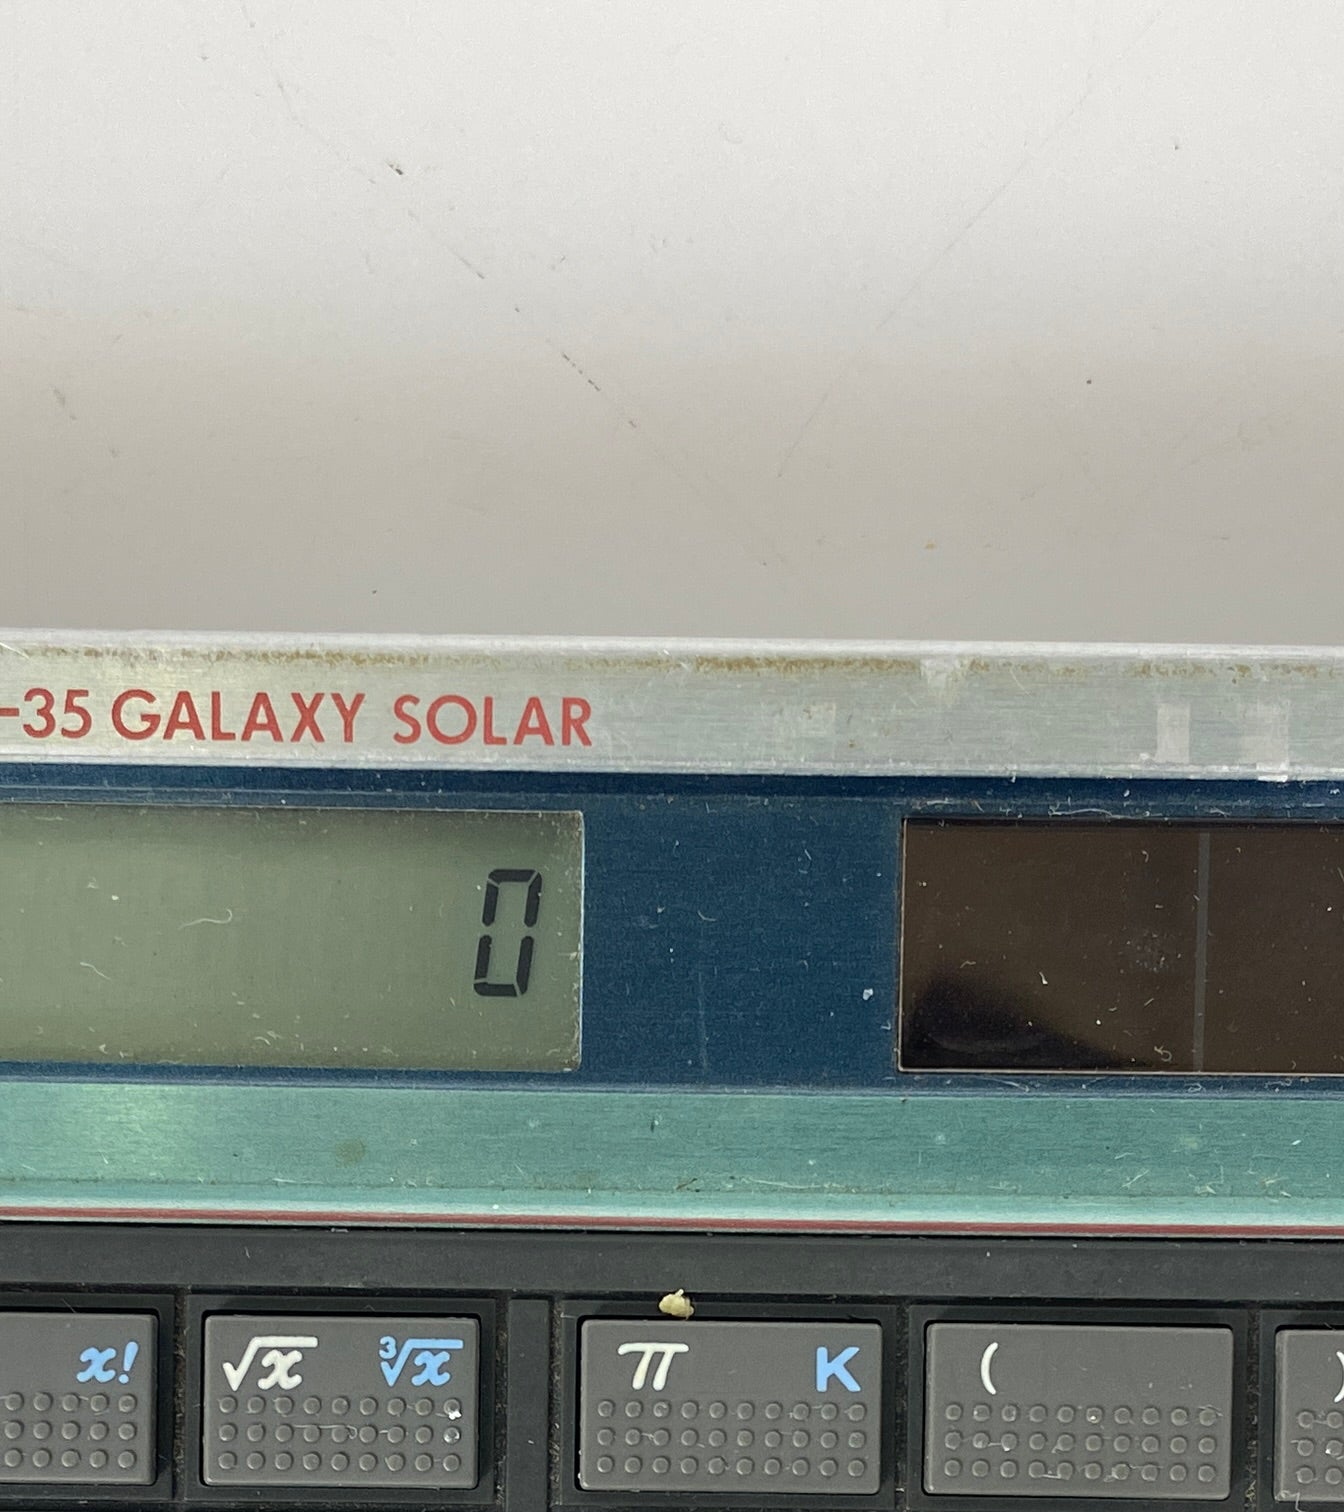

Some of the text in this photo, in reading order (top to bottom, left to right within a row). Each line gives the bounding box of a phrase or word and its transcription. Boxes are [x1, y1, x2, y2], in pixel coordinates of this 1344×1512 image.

[112, 689, 365, 742] GALAXY
[394, 695, 592, 746] SOLAR
[474, 869, 542, 997] 0
[77, 1342, 138, 1383] x!
[618, 1343, 860, 1392] π K
[981, 1343, 998, 1394] (
